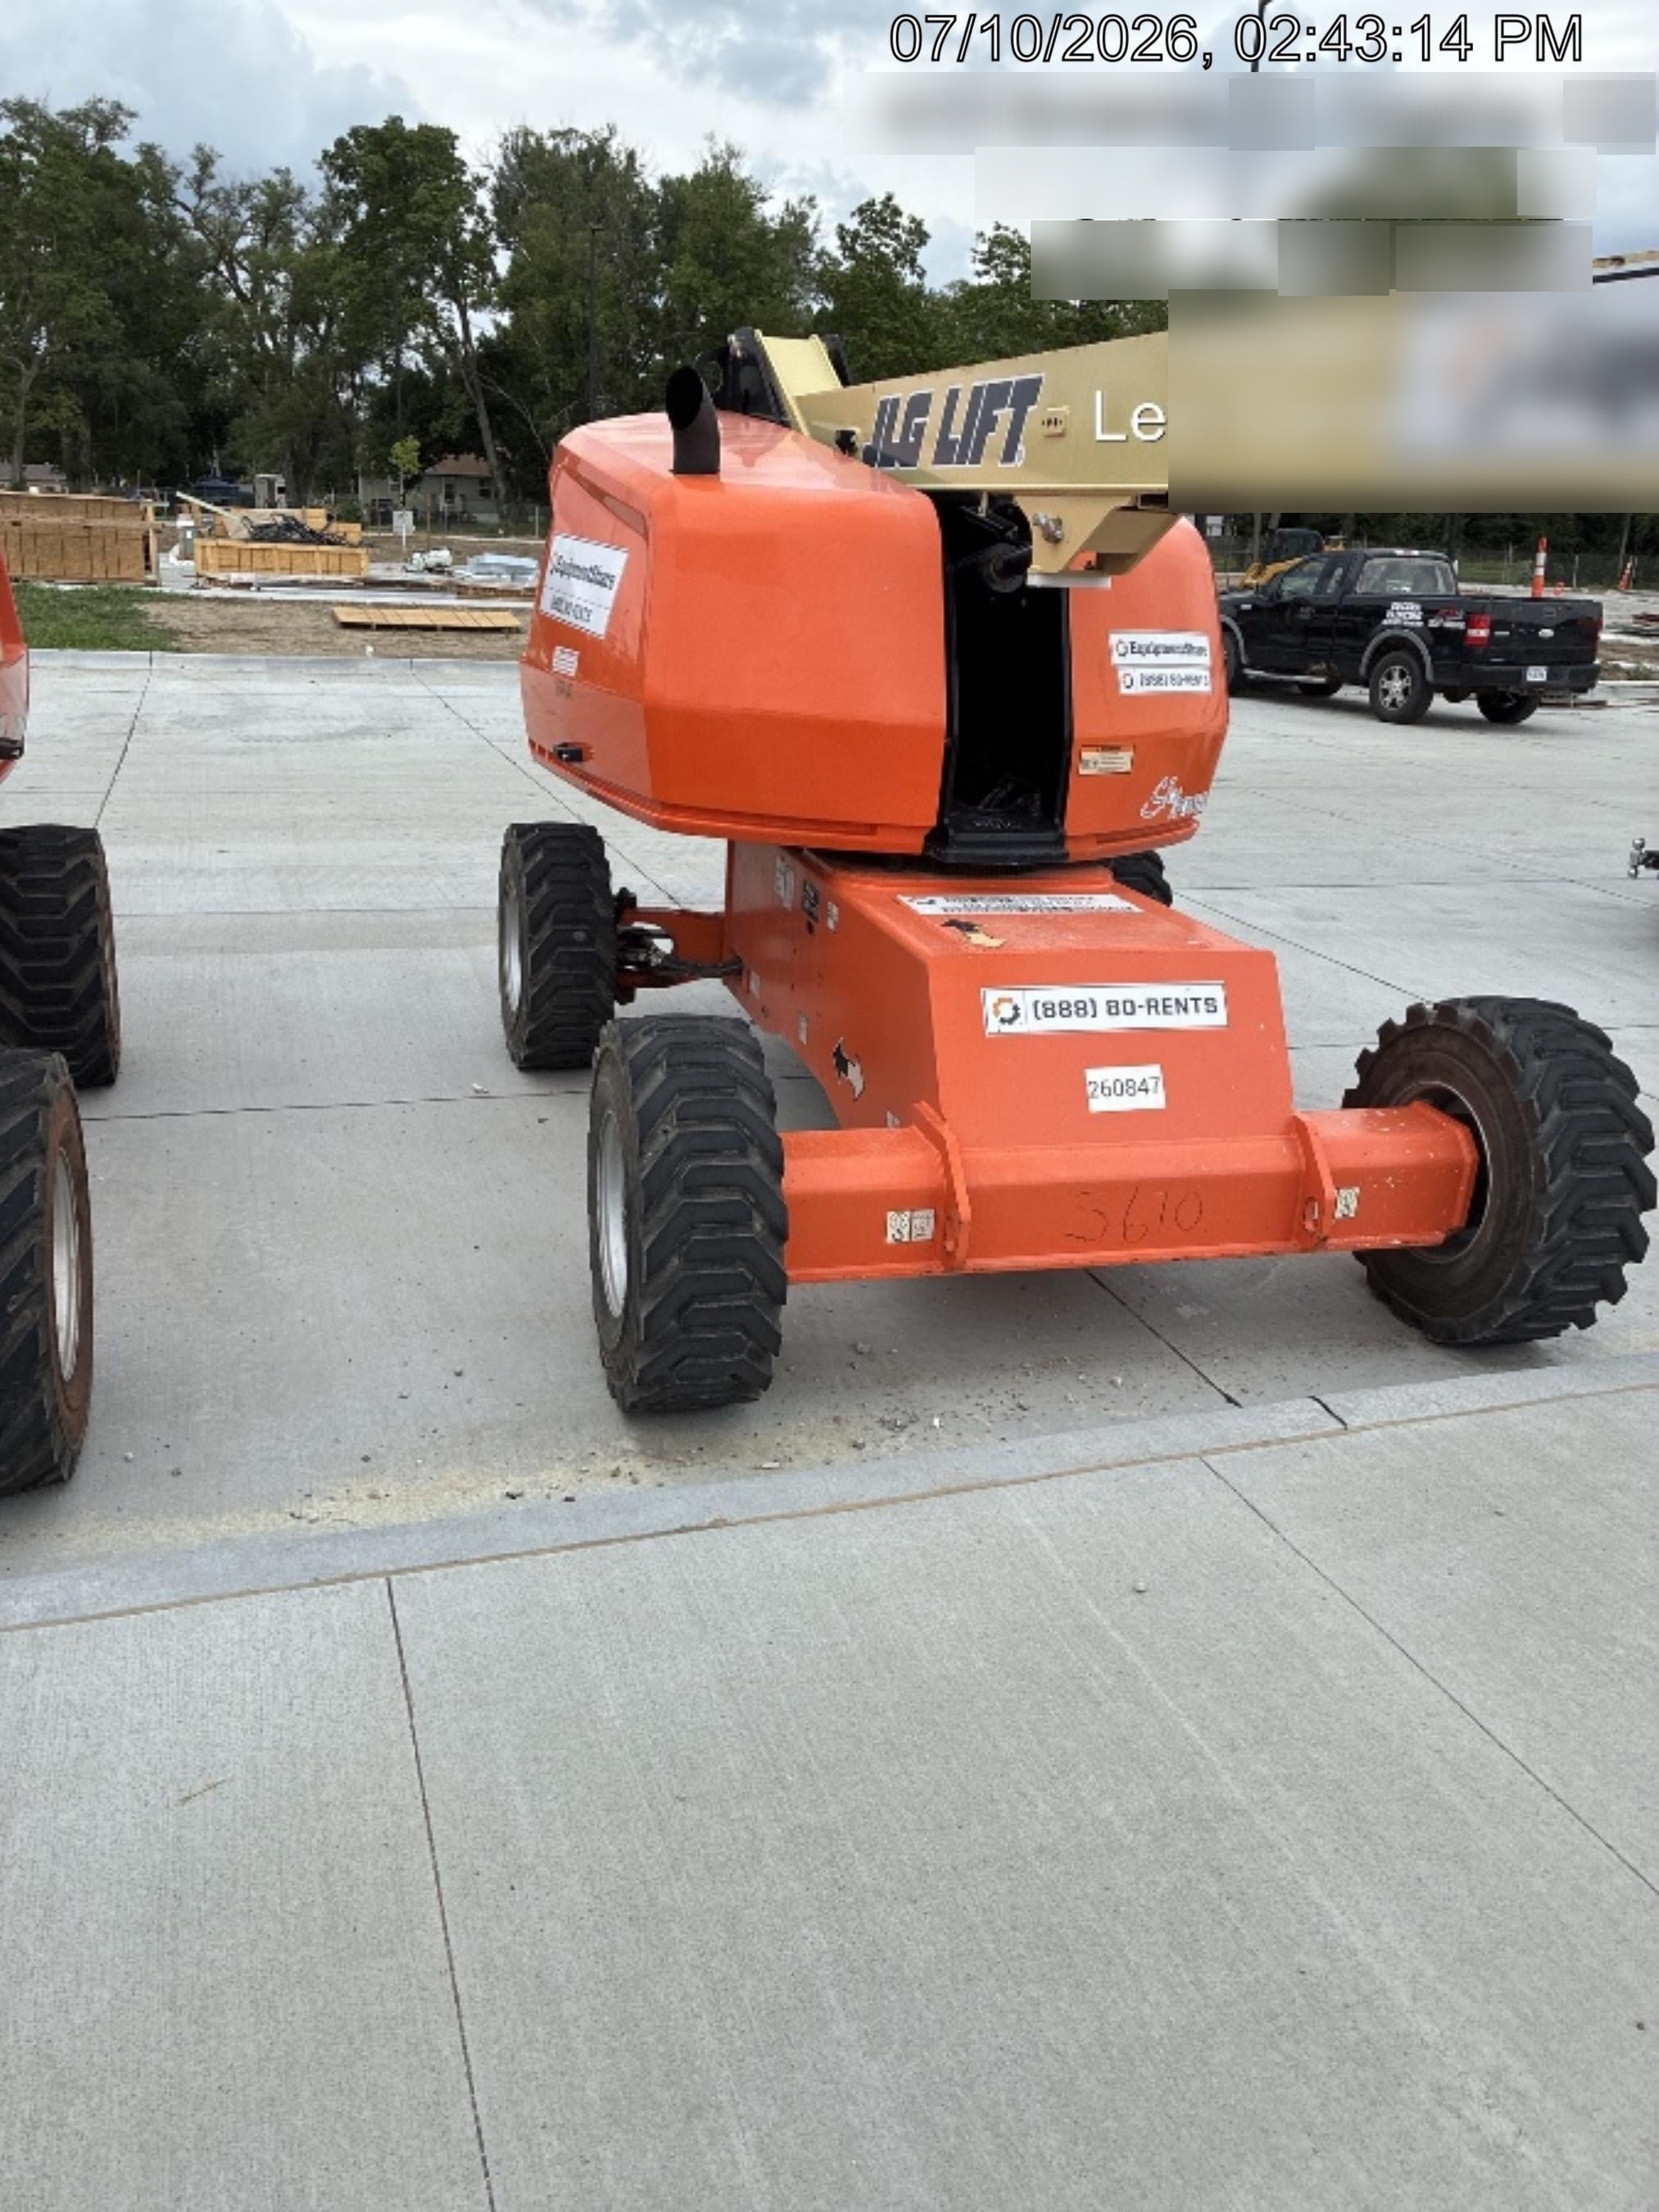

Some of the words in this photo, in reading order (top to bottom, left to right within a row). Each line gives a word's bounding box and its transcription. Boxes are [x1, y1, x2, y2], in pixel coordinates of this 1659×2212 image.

[930, 373, 1045, 468] LIFT
[1032, 999, 1098, 1019] (888)
[1087, 1076, 1162, 1099] 260847
